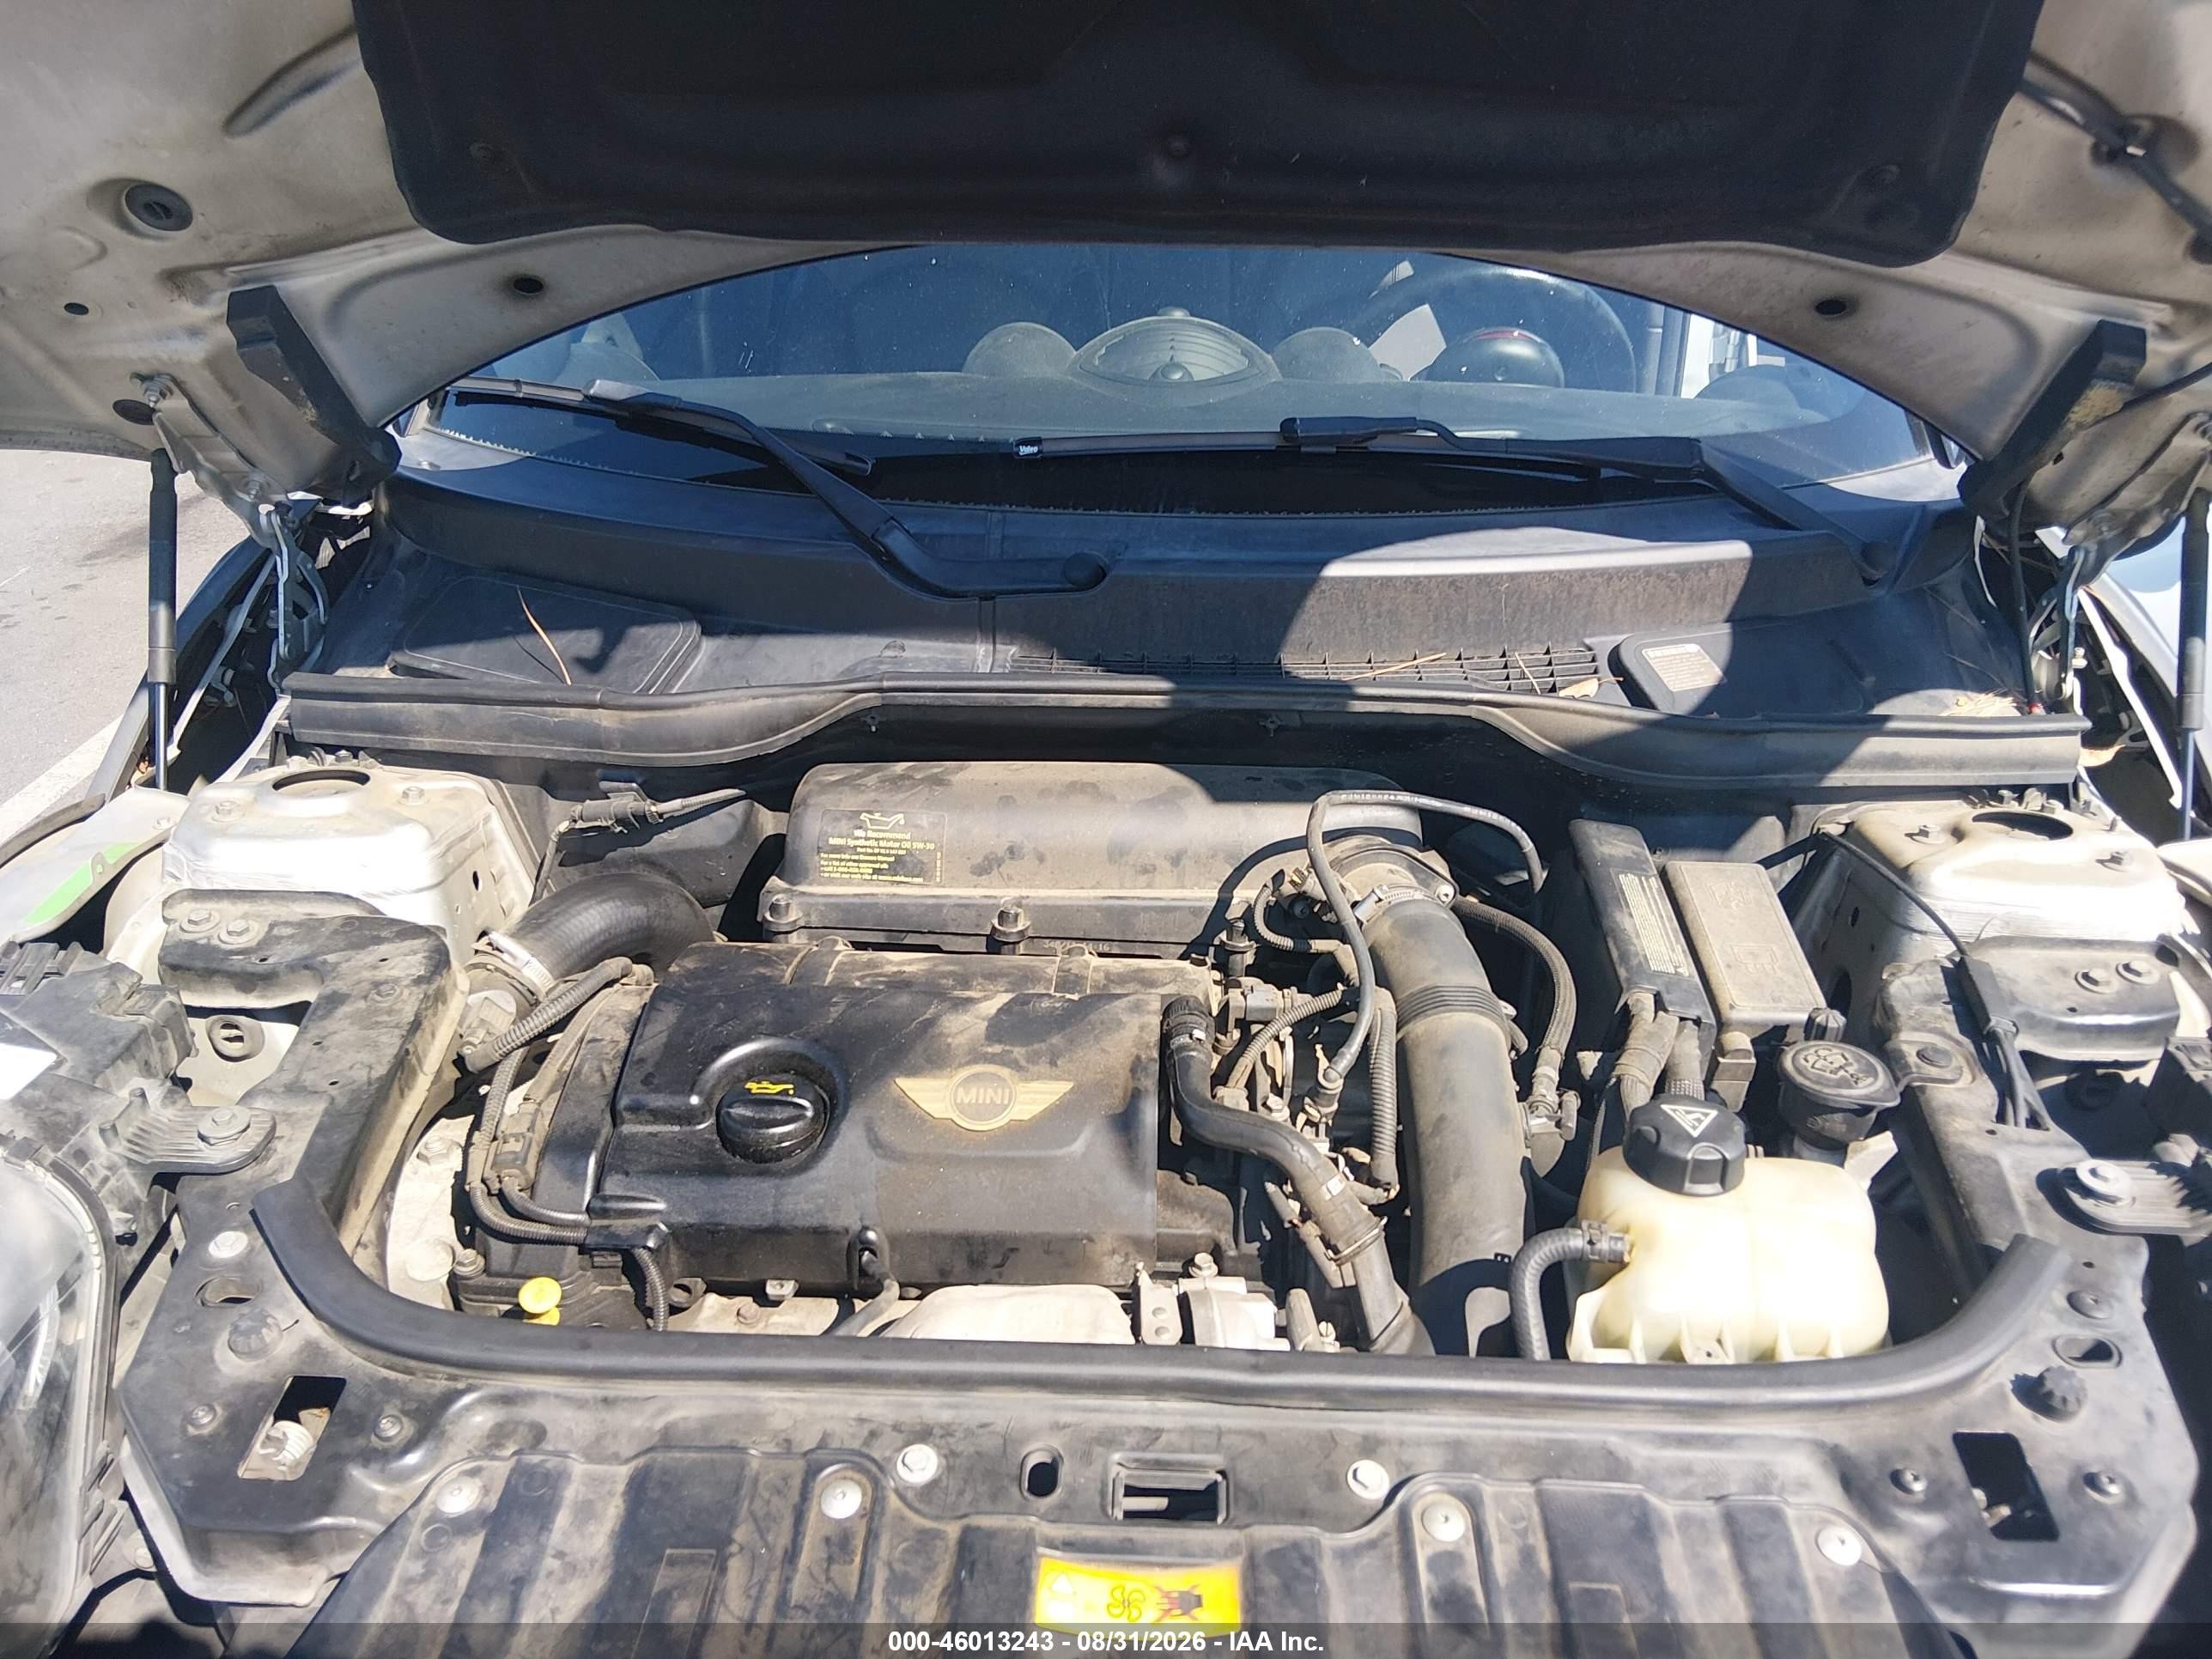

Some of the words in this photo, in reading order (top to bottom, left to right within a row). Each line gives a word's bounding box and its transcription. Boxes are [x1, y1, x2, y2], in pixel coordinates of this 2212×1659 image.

[866, 830, 910, 840] Recommend
[879, 840, 901, 848] Motor
[912, 842, 934, 850] 5W-30
[955, 1087, 1010, 1105] MINI
